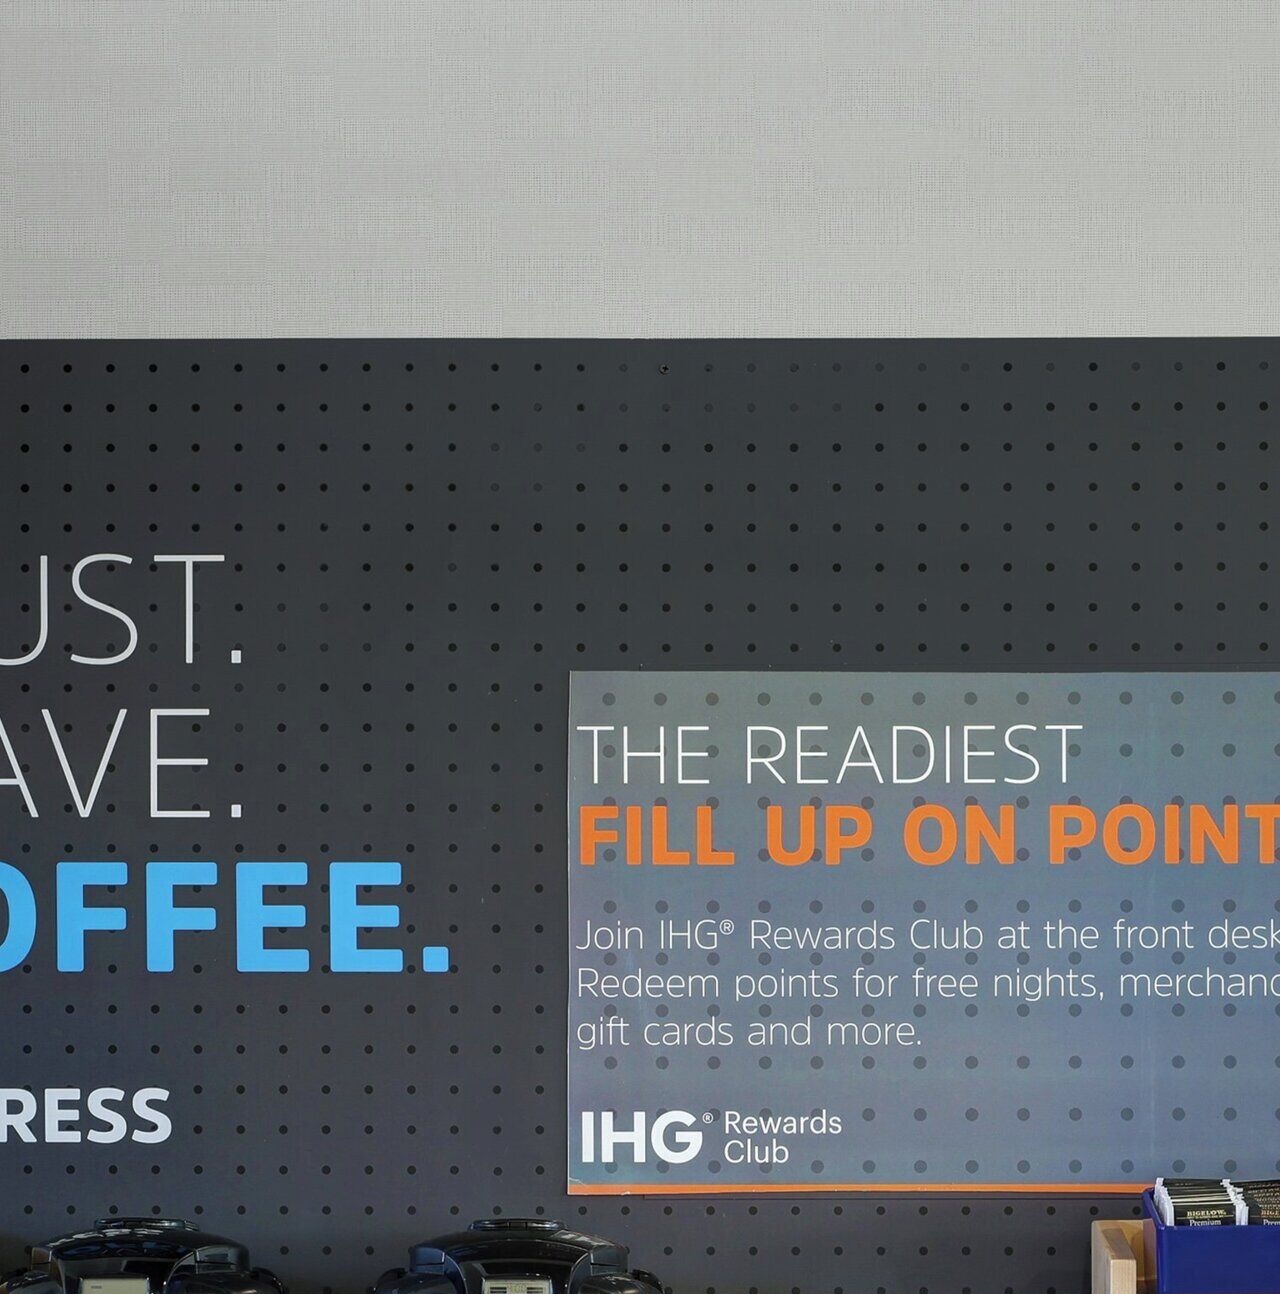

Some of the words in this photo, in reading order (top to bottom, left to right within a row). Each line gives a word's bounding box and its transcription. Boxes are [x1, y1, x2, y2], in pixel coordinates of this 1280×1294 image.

[576, 725, 710, 785] THE
[746, 723, 1084, 785] READIEST
[579, 804, 736, 866] FILL
[766, 804, 874, 867] UP
[903, 803, 1016, 866] ON
[575, 919, 644, 950] Join
[750, 919, 896, 950] Rewards
[910, 918, 984, 950] Club
[997, 920, 1031, 950] at
[1042, 918, 1100, 950] the
[1112, 918, 1195, 949] front
[578, 967, 719, 999] Redeem
[735, 967, 839, 1004] points
[851, 967, 899, 998] for
[911, 966, 979, 998] free
[994, 966, 1104, 1005] nights,
[576, 1015, 630, 1051] gift
[643, 1015, 734, 1046] cards
[747, 1015, 811, 1046] and
[827, 1022, 922, 1046] more.
[724, 1109, 843, 1135] Rewards
[723, 1138, 790, 1164] Club
